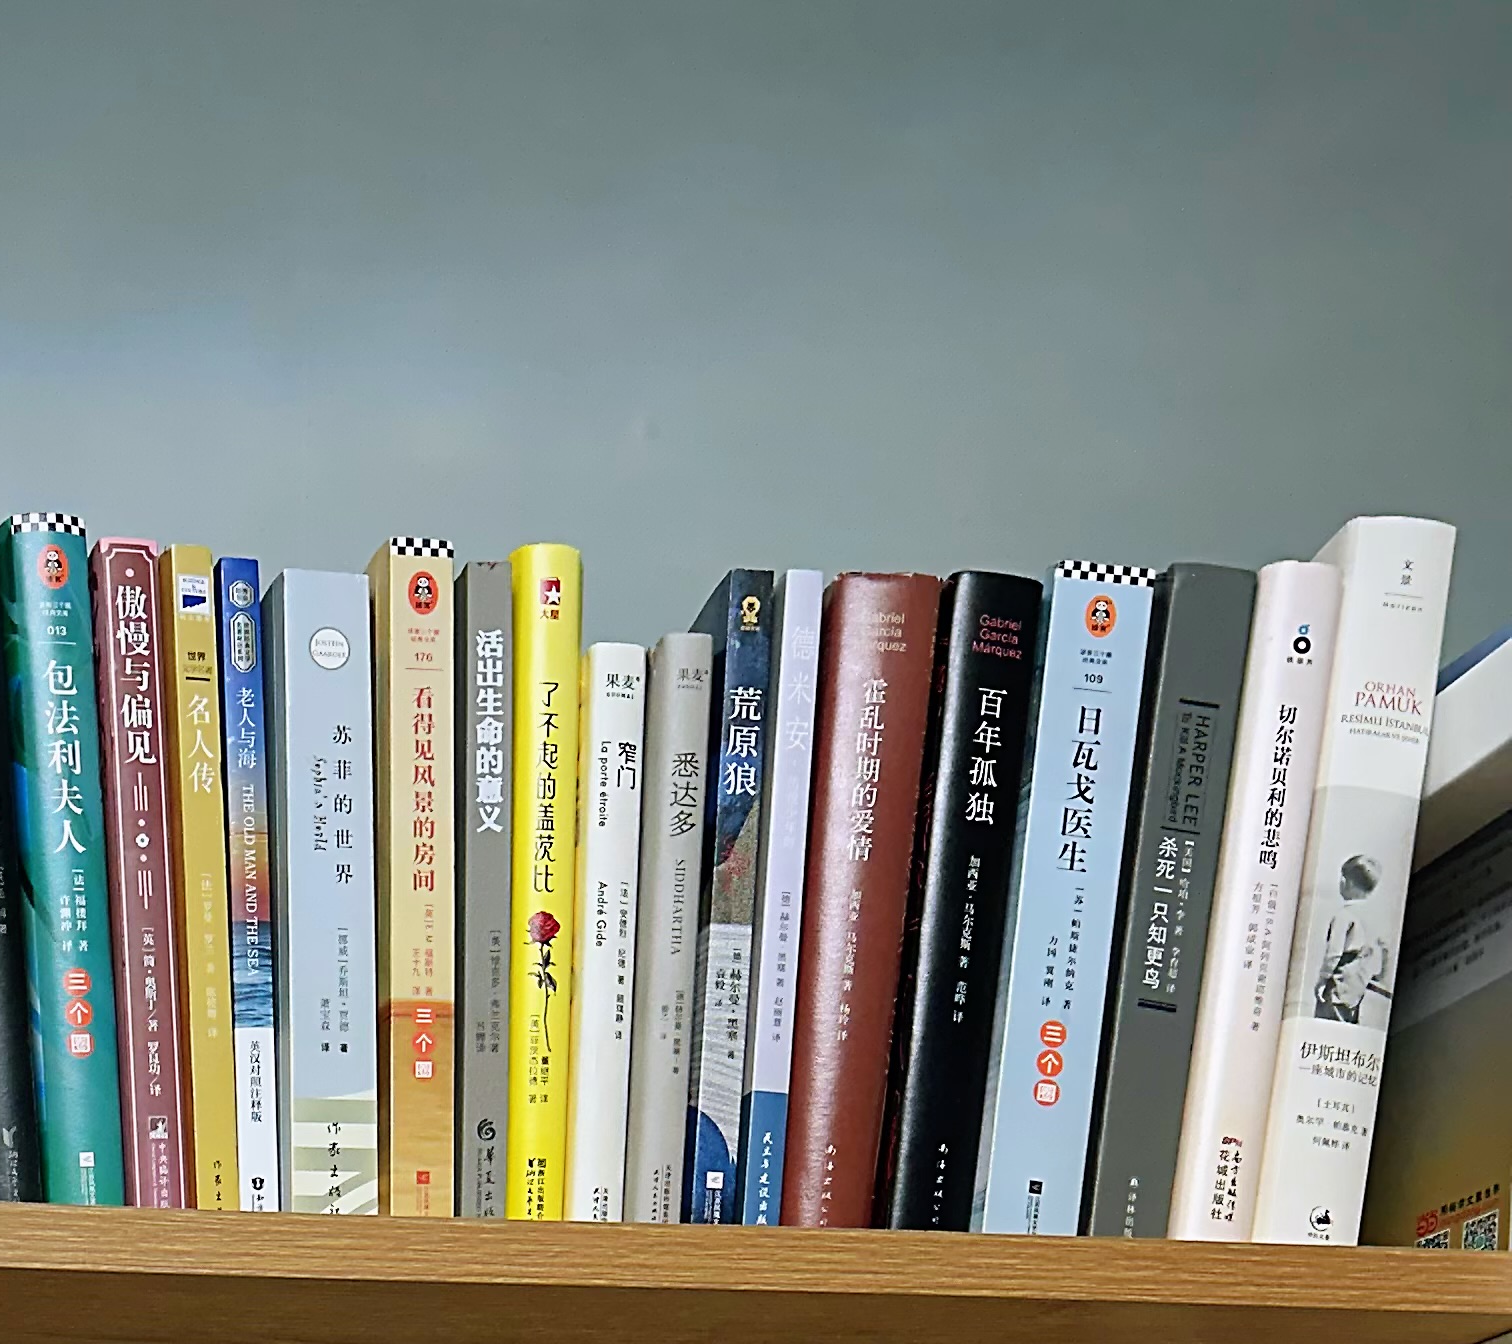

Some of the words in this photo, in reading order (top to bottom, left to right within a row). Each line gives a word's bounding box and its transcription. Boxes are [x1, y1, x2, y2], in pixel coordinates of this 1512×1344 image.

[46, 625, 68, 636] 013
[979, 613, 1023, 631] Gabriel
[115, 585, 157, 765] 傲慢与偏见
[785, 626, 817, 752] 德米安
[1083, 673, 1104, 684] 109
[1354, 691, 1422, 715] PAMUK
[1364, 680, 1417, 698] ORHAN
[43, 659, 87, 854] 包法利夫人
[186, 694, 216, 795] 名人传
[235, 687, 257, 770] 老人与海
[475, 629, 505, 834] 活出生命的意义
[616, 741, 637, 790] 窄门
[724, 686, 764, 797] 荒原狼
[847, 678, 889, 862] 霍乱时期的爱情
[965, 687, 1008, 826] 百年孤独
[242, 783, 255, 814] THE
[332, 724, 354, 885] 苏菲的世界
[411, 686, 436, 893] 看得见风景的房间
[533, 681, 560, 894] 了不起的盖茨比
[669, 752, 700, 837] 悉达多
[1057, 705, 1103, 874] 日瓦戈医生
[1259, 703, 1298, 869] 切尔诺贝利的悲鸣
[243, 816, 257, 845] OLD
[244, 849, 258, 881] MAN
[245, 883, 258, 914] AND
[246, 915, 259, 946] THE
[670, 859, 686, 956] SIDDHARTHA
[1141, 836, 1179, 991] 杀死一只知更鸟
[247, 948, 261, 977] SEA
[250, 1040, 263, 1123] 英汉对照注释版
[1299, 1040, 1380, 1072] 伊斯坦布尔
